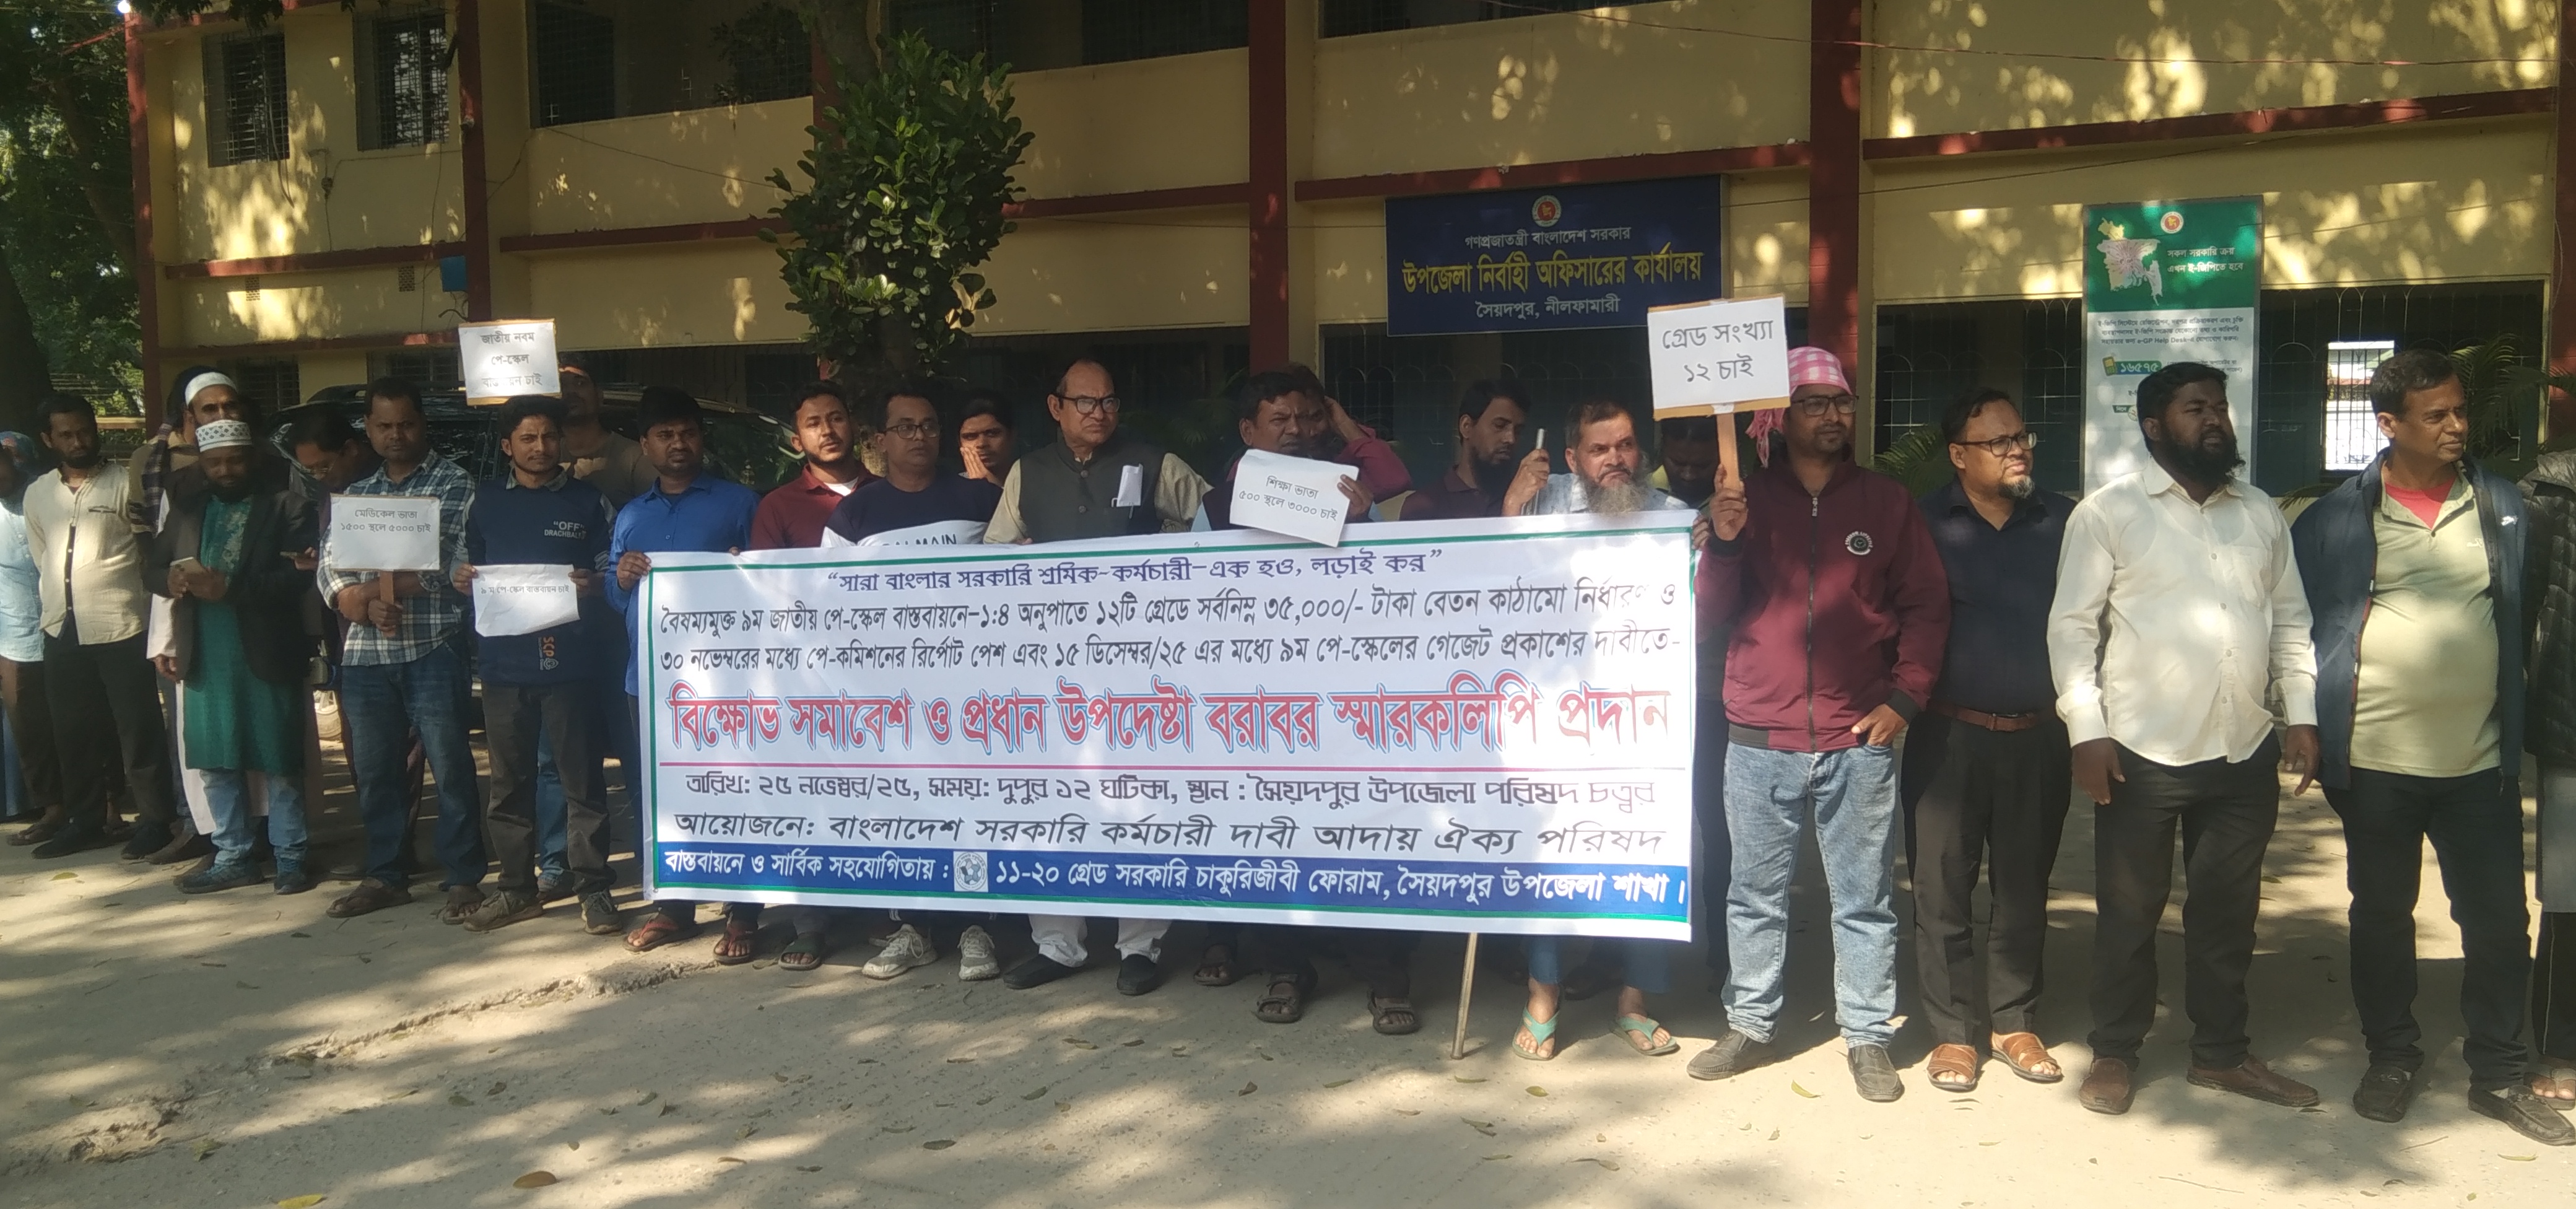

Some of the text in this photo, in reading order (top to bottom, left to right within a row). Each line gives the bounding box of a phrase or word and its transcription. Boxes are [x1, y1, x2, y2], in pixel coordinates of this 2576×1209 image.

[1465, 227, 1632, 249] গণপ্রজাতন্ত্রী বাংলাদেশ সরকার
[2167, 249, 2187, 258] সকল
[2190, 246, 2217, 258] সরকারি
[1402, 242, 1705, 294] উপজেলা নির্বাহী অফিসারের কার্যালয়
[2167, 261, 2243, 273] এখন ই-জিপিতে হবে
[1475, 293, 1621, 320] সৈয়দপুর, নীলফামারী
[480, 330, 535, 344] জাতীয় নবম
[1662, 320, 1773, 350] গ্রেড সংখ্যা
[491, 354, 529, 365] পে-স্কেল
[1684, 354, 1754, 383] ১২ চাই
[2120, 362, 2159, 373] ১৬৫৭৫
[524, 373, 542, 386] চাই
[1266, 475, 1318, 499] শিক্ষা ভাতা
[355, 507, 417, 519] মেডিকেল ভাতা
[1239, 491, 1338, 522] ৫০০ স্থলে ৩০০০ চাই
[341, 523, 365, 531] ১৫০০
[388, 524, 414, 532] ৫০০০
[417, 522, 432, 533] চাই
[885, 572, 952, 590] বাংলার
[957, 564, 1033, 587] সরকারি
[1256, 559, 1302, 578] হও,
[1310, 548, 1377, 579] লড়াই
[558, 583, 570, 593] চাই
[660, 604, 737, 639] বৈষম্যমুক্ত
[741, 609, 764, 632] ৯ম
[770, 600, 818, 632] জাতীয়
[824, 606, 887, 632] পে-স্কেল
[1017, 599, 1090, 634] অনুপাতে
[1096, 591, 1138, 627] ১২টি
[1145, 595, 1191, 626] গ্রেডে
[1196, 587, 1257, 626] সর্বনিম্ন
[1264, 588, 1364, 626] ৩৫,০০০/-
[1370, 583, 1417, 619] টাকা
[1424, 589, 1482, 618] বেতন
[1487, 575, 1569, 616] কাঠামো
[1660, 584, 1676, 605] ও
[660, 650, 684, 671] ৩০
[690, 648, 760, 672] নভেম্বরের
[765, 647, 803, 671] মধ্যে
[806, 637, 907, 671] পে-কমিশনের
[971, 640, 1007, 668] পেশ
[1012, 643, 1048, 670] এবং
[1055, 642, 1080, 667] ১৫
[1085, 632, 1187, 670] ডিসেম্বর/২৫
[1195, 639, 1224, 665] এর
[1230, 638, 1274, 665] মধ্যে
[1279, 637, 1310, 663] ৯ম
[1316, 634, 1419, 663] পে-স্কেলের
[1426, 624, 1494, 661] গেজেট
[1500, 627, 1588, 661] প্রকাশের
[665, 668, 1671, 756] বিক্ষোভ সমাবেশ ও প্রধান উপদেষ্টা বরাবর স্মারকলিপি প্রদান
[685, 770, 750, 796] তারিখ:
[759, 775, 792, 796] ২৫
[798, 773, 920, 801] নভেম্বর/২৫,
[928, 777, 989, 801] সময়:
[997, 777, 1049, 805] দুপুর
[1056, 779, 1090, 800] ১২
[1099, 774, 1178, 805] ঘটিকা,
[1185, 780, 1229, 804] স্থান
[1246, 773, 1360, 810] সৈয়দপুর
[1367, 775, 1476, 804] উপজেলা
[1485, 777, 1579, 808] পরিষদ
[1588, 782, 1655, 814] চত্বর
[674, 811, 1667, 855] আয়োজনে: বাংলাদেশ সরকারি কর্মচারী দাবী আদায় ঐক্য পরিষদ
[664, 849, 745, 875] বাস্তবায়নে
[751, 856, 765, 874] ও
[771, 847, 824, 878] সার্বিক
[829, 850, 936, 881] সহযোগিতায়
[996, 861, 1059, 887] ১১-২০
[1068, 860, 1110, 887] গ্রেড
[1115, 858, 1190, 888] সরকারি
[1195, 858, 1300, 897] চাকুরিজীবী
[1308, 867, 1391, 900] ফোরাম,
[1397, 864, 1494, 906] সৈয়দপুর
[1500, 866, 1606, 902] উপজেলা
[1612, 871, 1670, 902] শাখা
